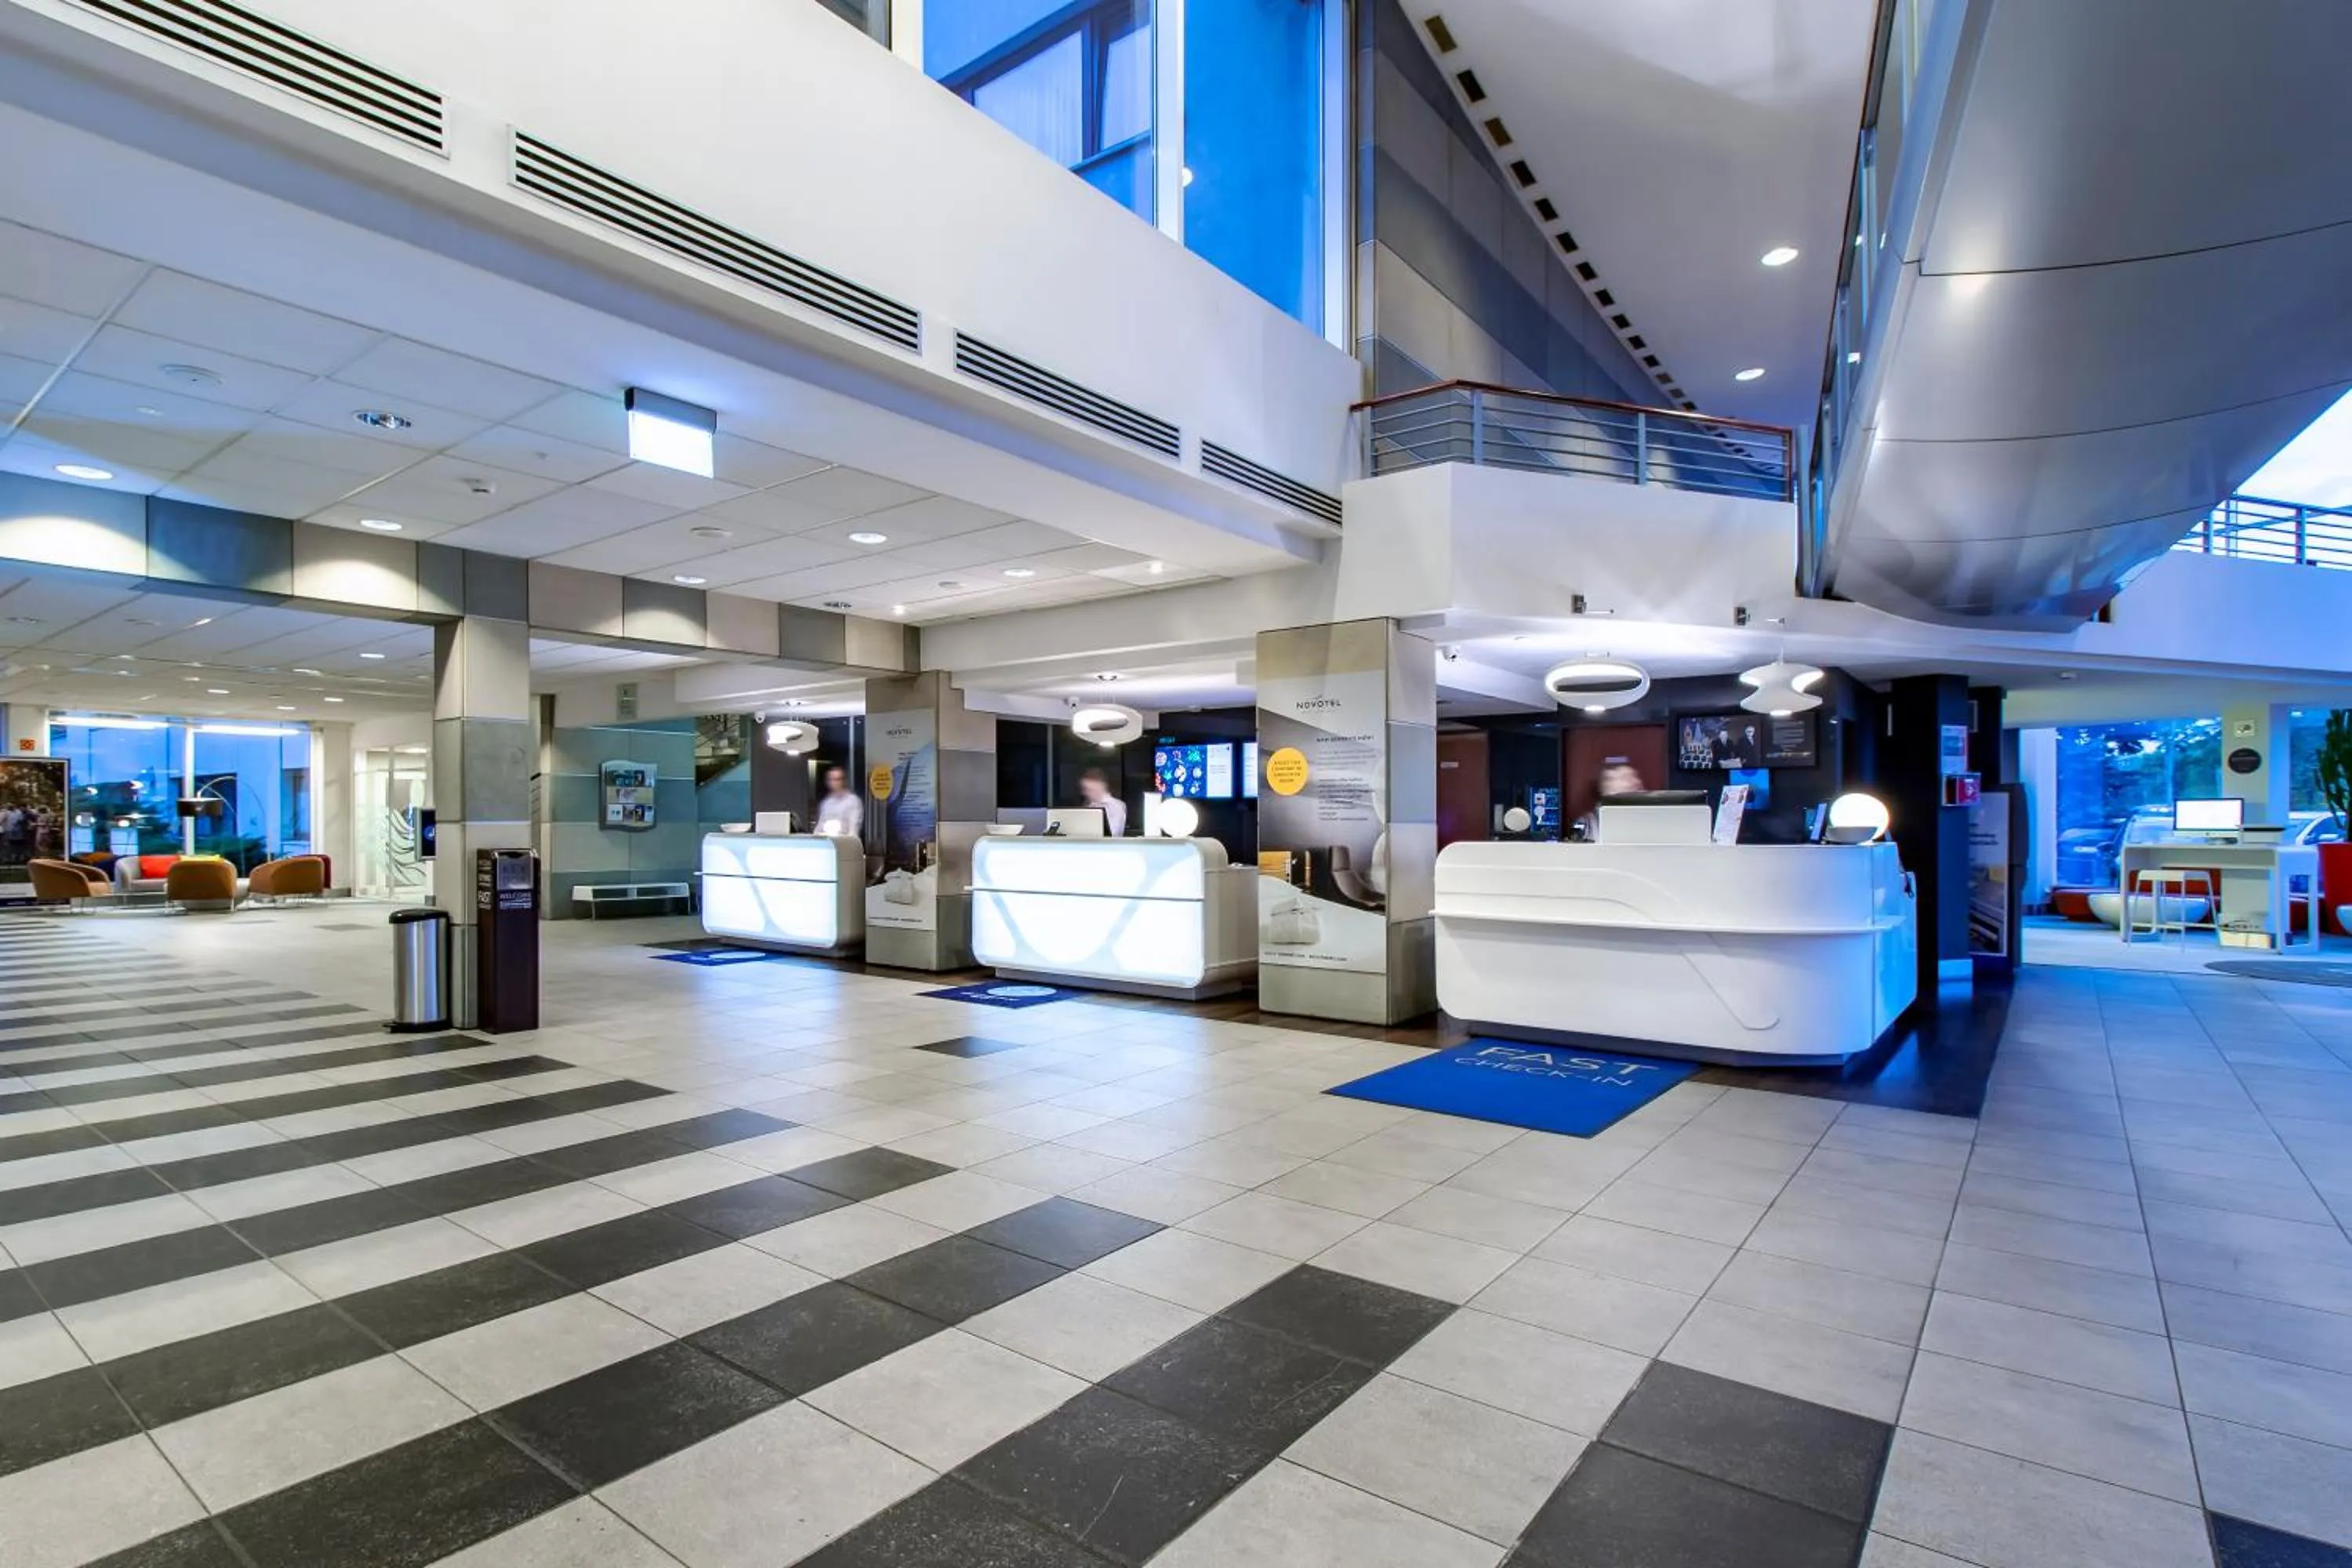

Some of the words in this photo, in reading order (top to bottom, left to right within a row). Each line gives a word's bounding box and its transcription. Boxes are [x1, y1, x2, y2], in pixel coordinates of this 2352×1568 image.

[1296, 699, 1341, 709] NOVOTEL
[1455, 1058, 1632, 1086] CHECK-IN
[1476, 1047, 1659, 1074] FAST
